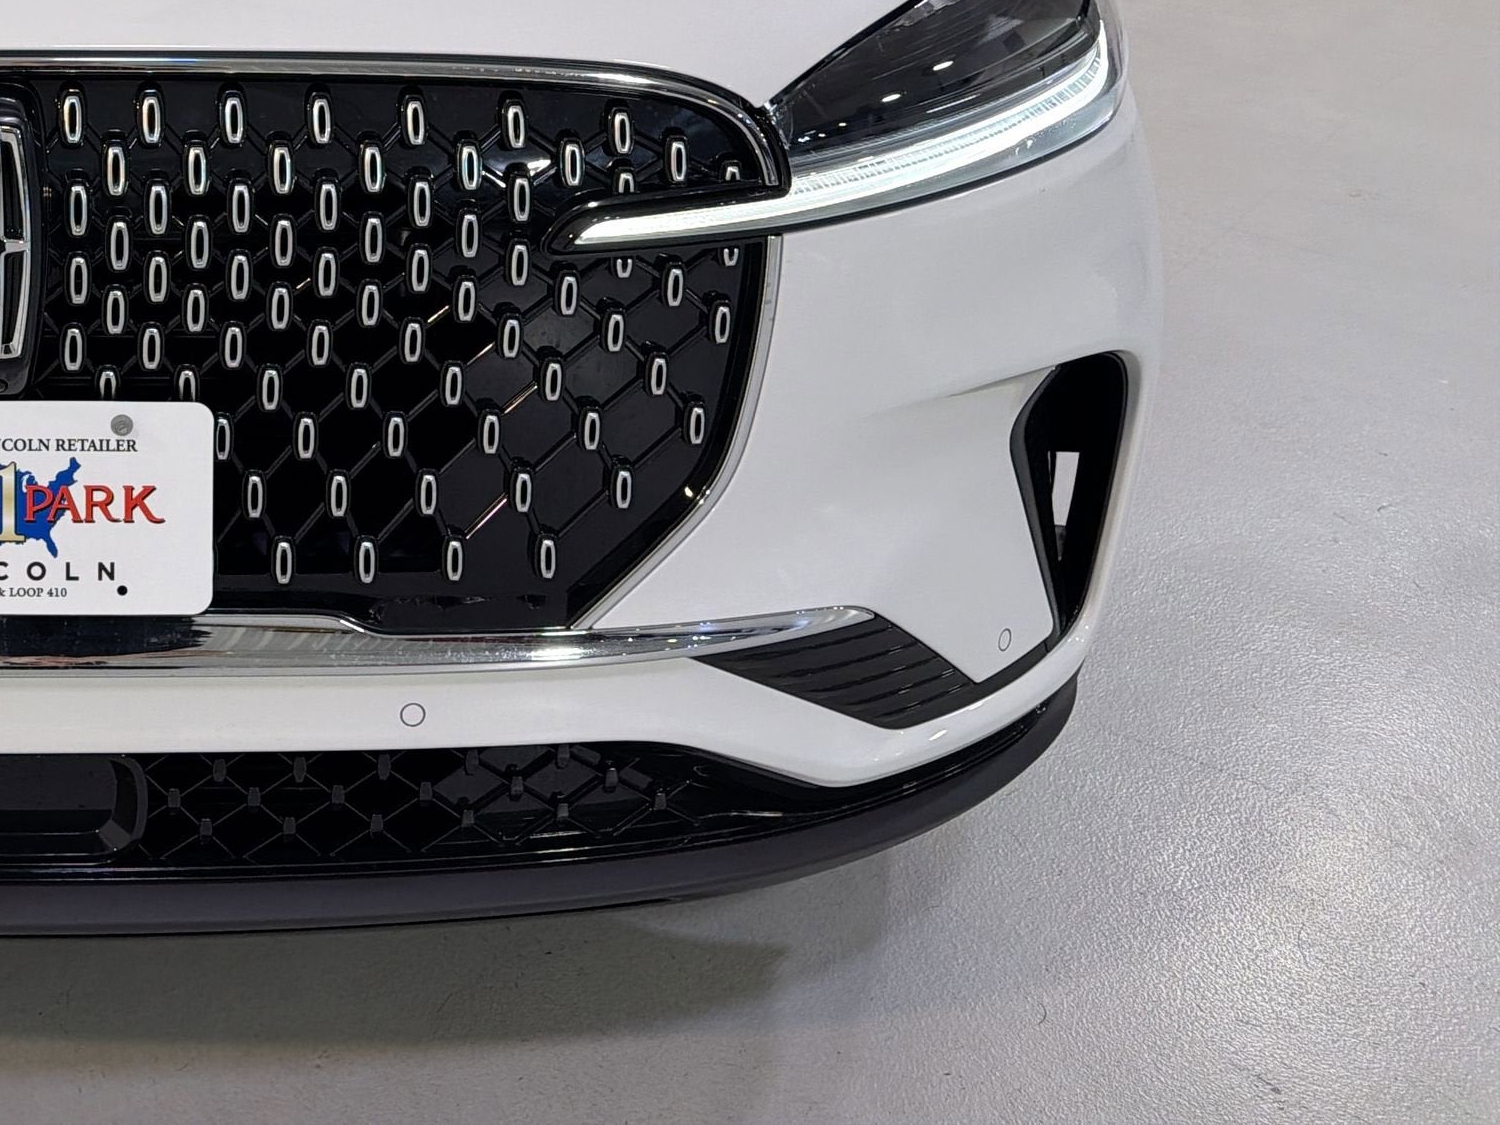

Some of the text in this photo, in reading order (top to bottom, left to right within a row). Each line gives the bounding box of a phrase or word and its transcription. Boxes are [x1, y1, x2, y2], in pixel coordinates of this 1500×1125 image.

[55, 438, 139, 453] RETAILER
[23, 484, 167, 525] PARK
[8, 586, 45, 599] LOOP
[46, 586, 68, 599] 410
